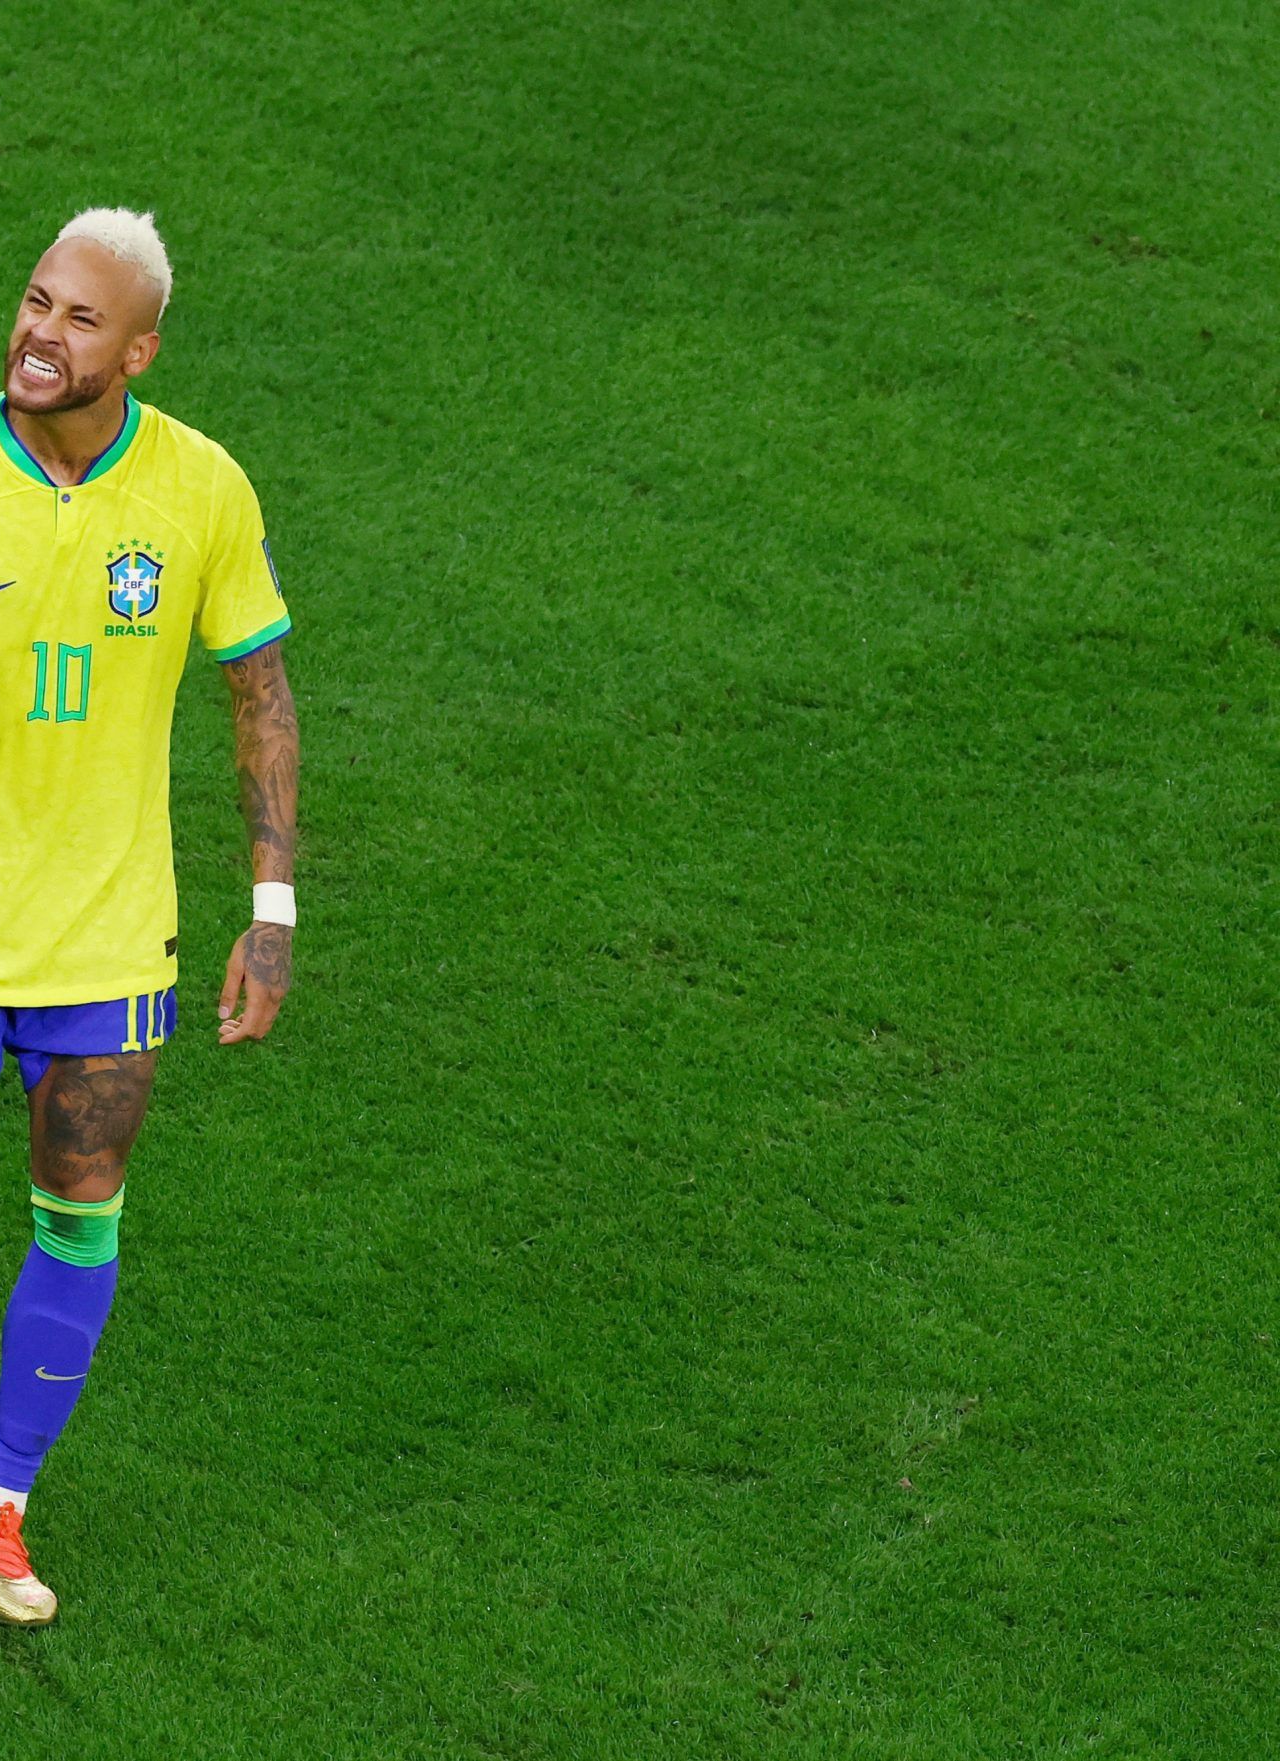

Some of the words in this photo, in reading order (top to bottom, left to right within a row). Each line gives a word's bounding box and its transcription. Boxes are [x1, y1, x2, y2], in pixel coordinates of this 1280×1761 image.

[123, 580, 144, 589] CBF
[105, 625, 158, 636] BRASIL
[27, 642, 91, 722] 10
